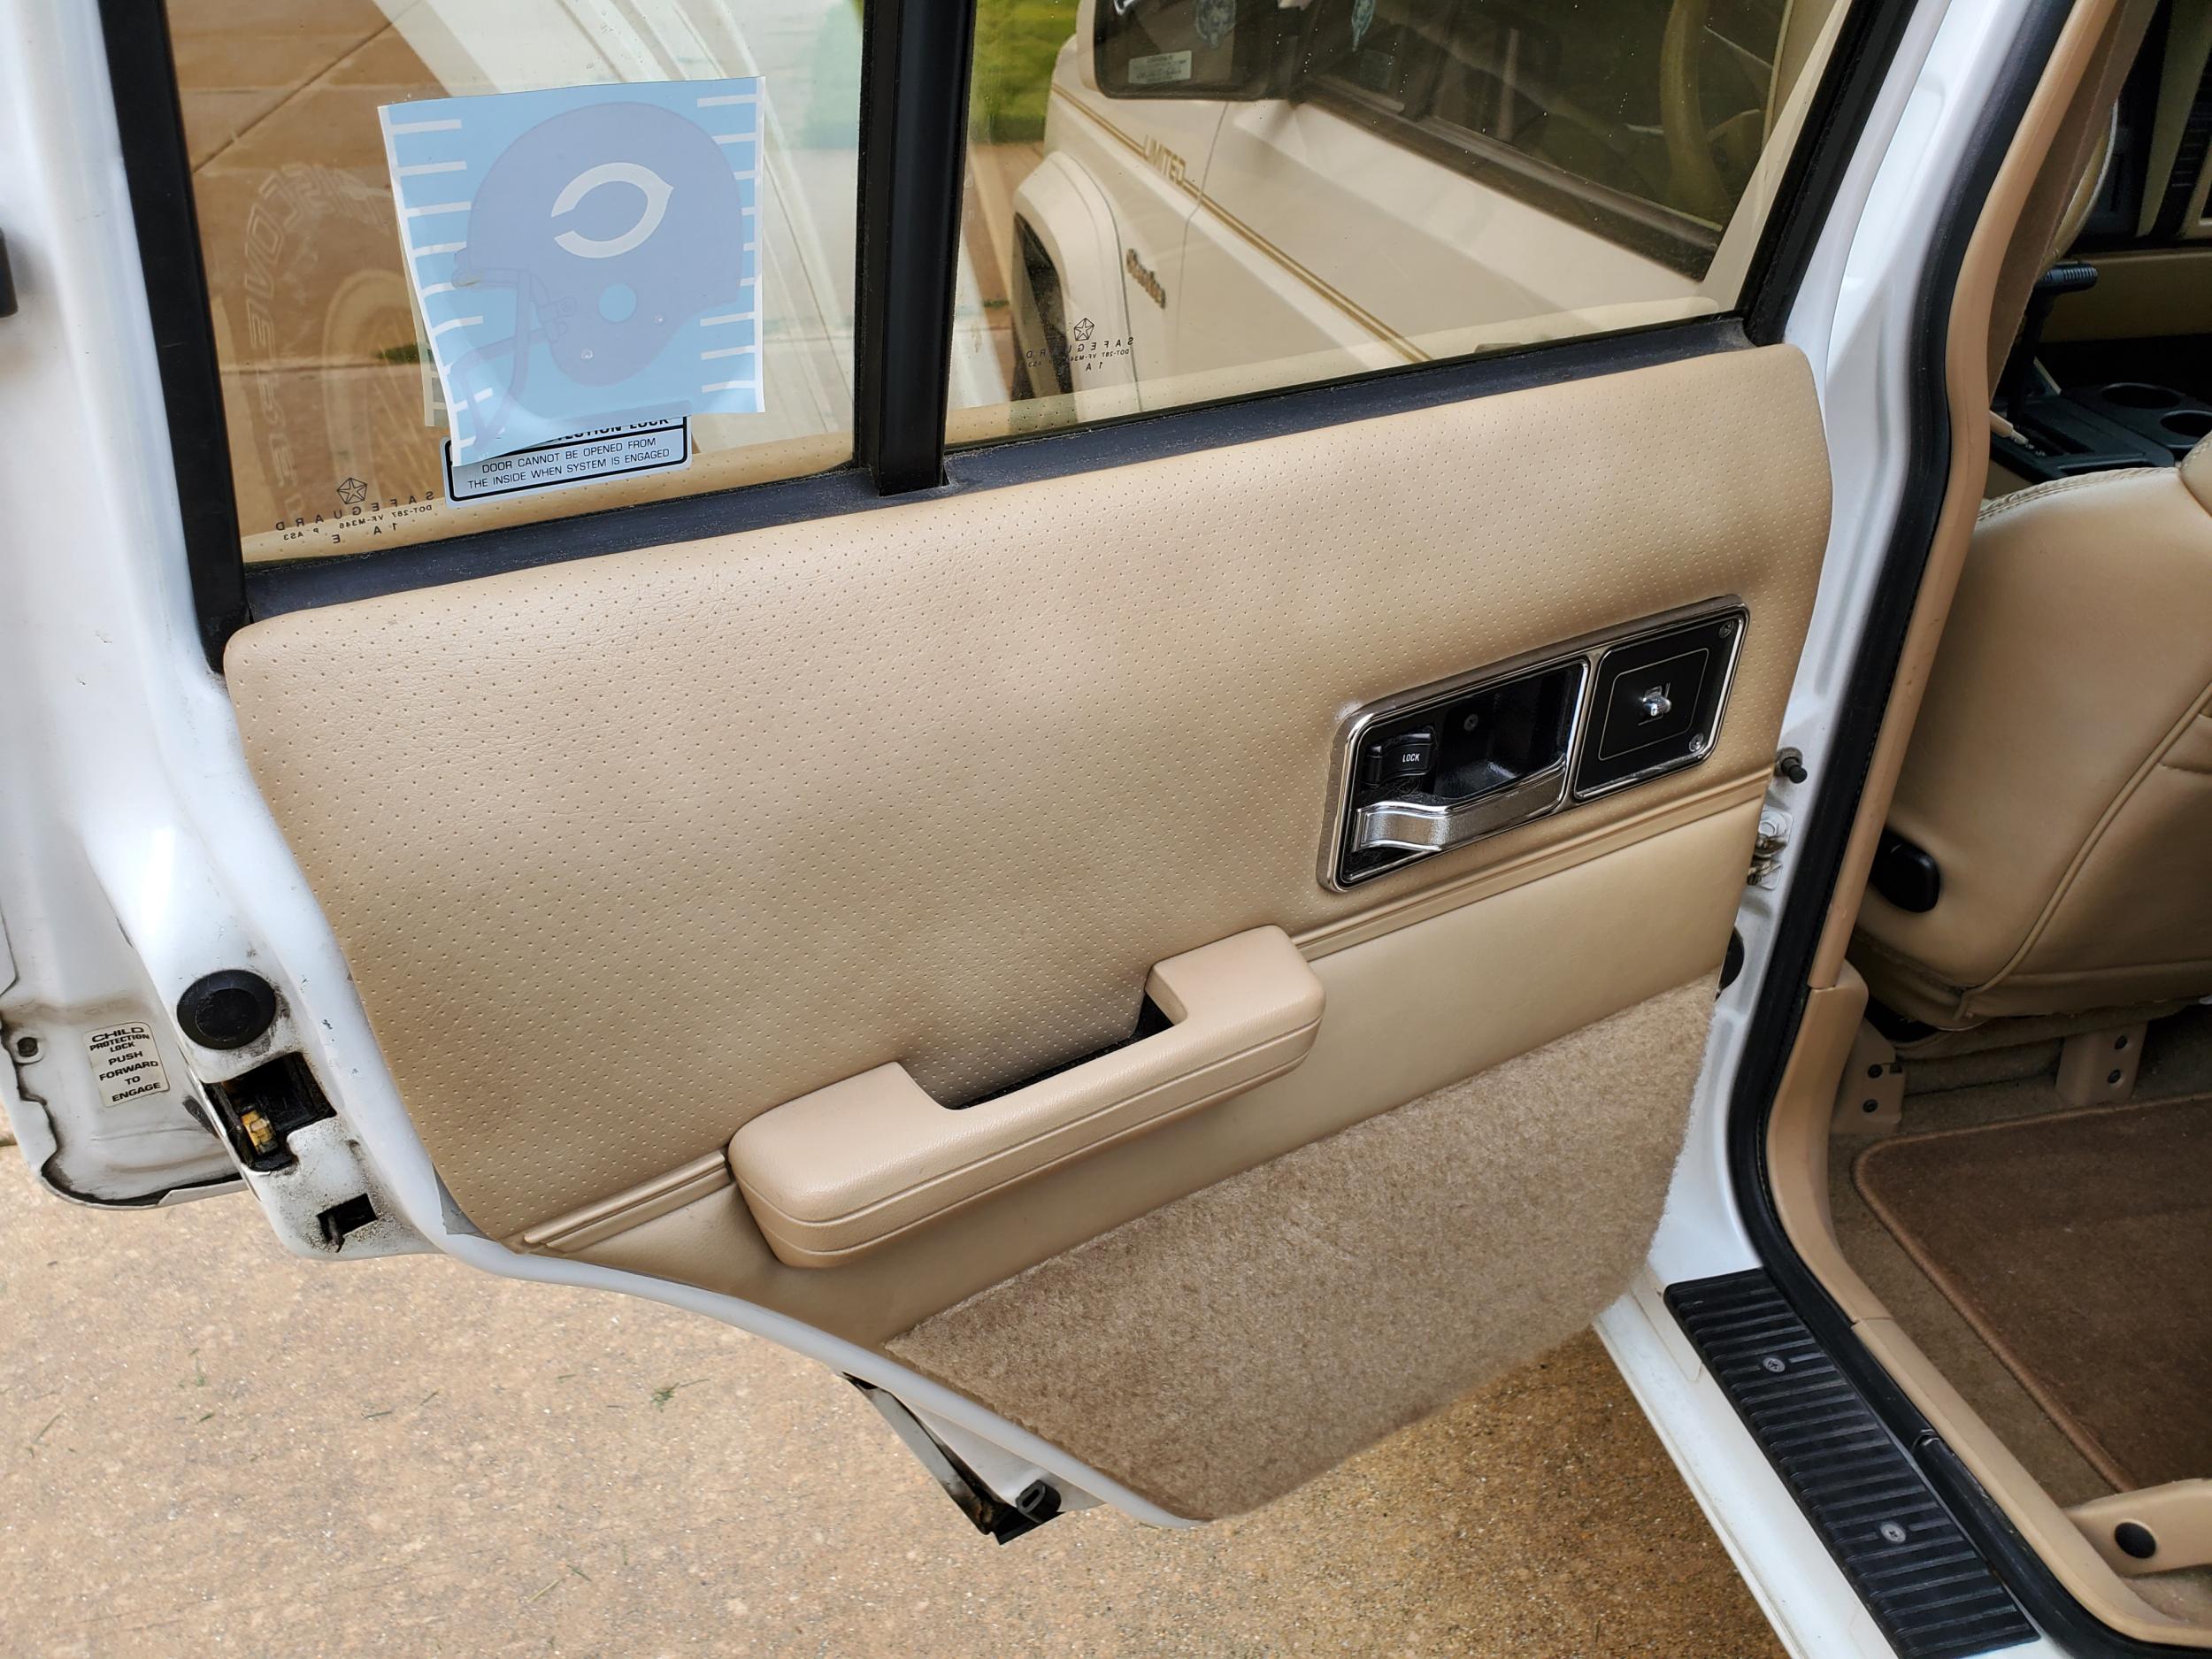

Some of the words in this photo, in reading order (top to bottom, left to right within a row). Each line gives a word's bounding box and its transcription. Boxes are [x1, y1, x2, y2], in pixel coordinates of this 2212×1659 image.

[481, 459, 513, 474] DOOR
[518, 451, 560, 468] CANNOT
[565, 449, 579, 461] BE
[583, 442, 623, 457] OPENED
[626, 437, 657, 450] FROM
[467, 478, 488, 490] THE
[492, 471, 526, 487] INSIDE
[531, 465, 563, 480] WHEN
[566, 458, 607, 473] SYSTEM
[611, 456, 620, 466] IS
[625, 448, 671, 465] ENGAGED
[1402, 753, 1421, 763] LOCK
[89, 1033, 150, 1051] PROTECTION
[91, 1026, 145, 1043] CHILD
[110, 1041, 135, 1053] LOCK
[108, 1050, 143, 1065] PUSH
[98, 1060, 159, 1081] FORWARD
[124, 1076, 142, 1086] TO
[111, 1082, 162, 1102] ENGAGE
